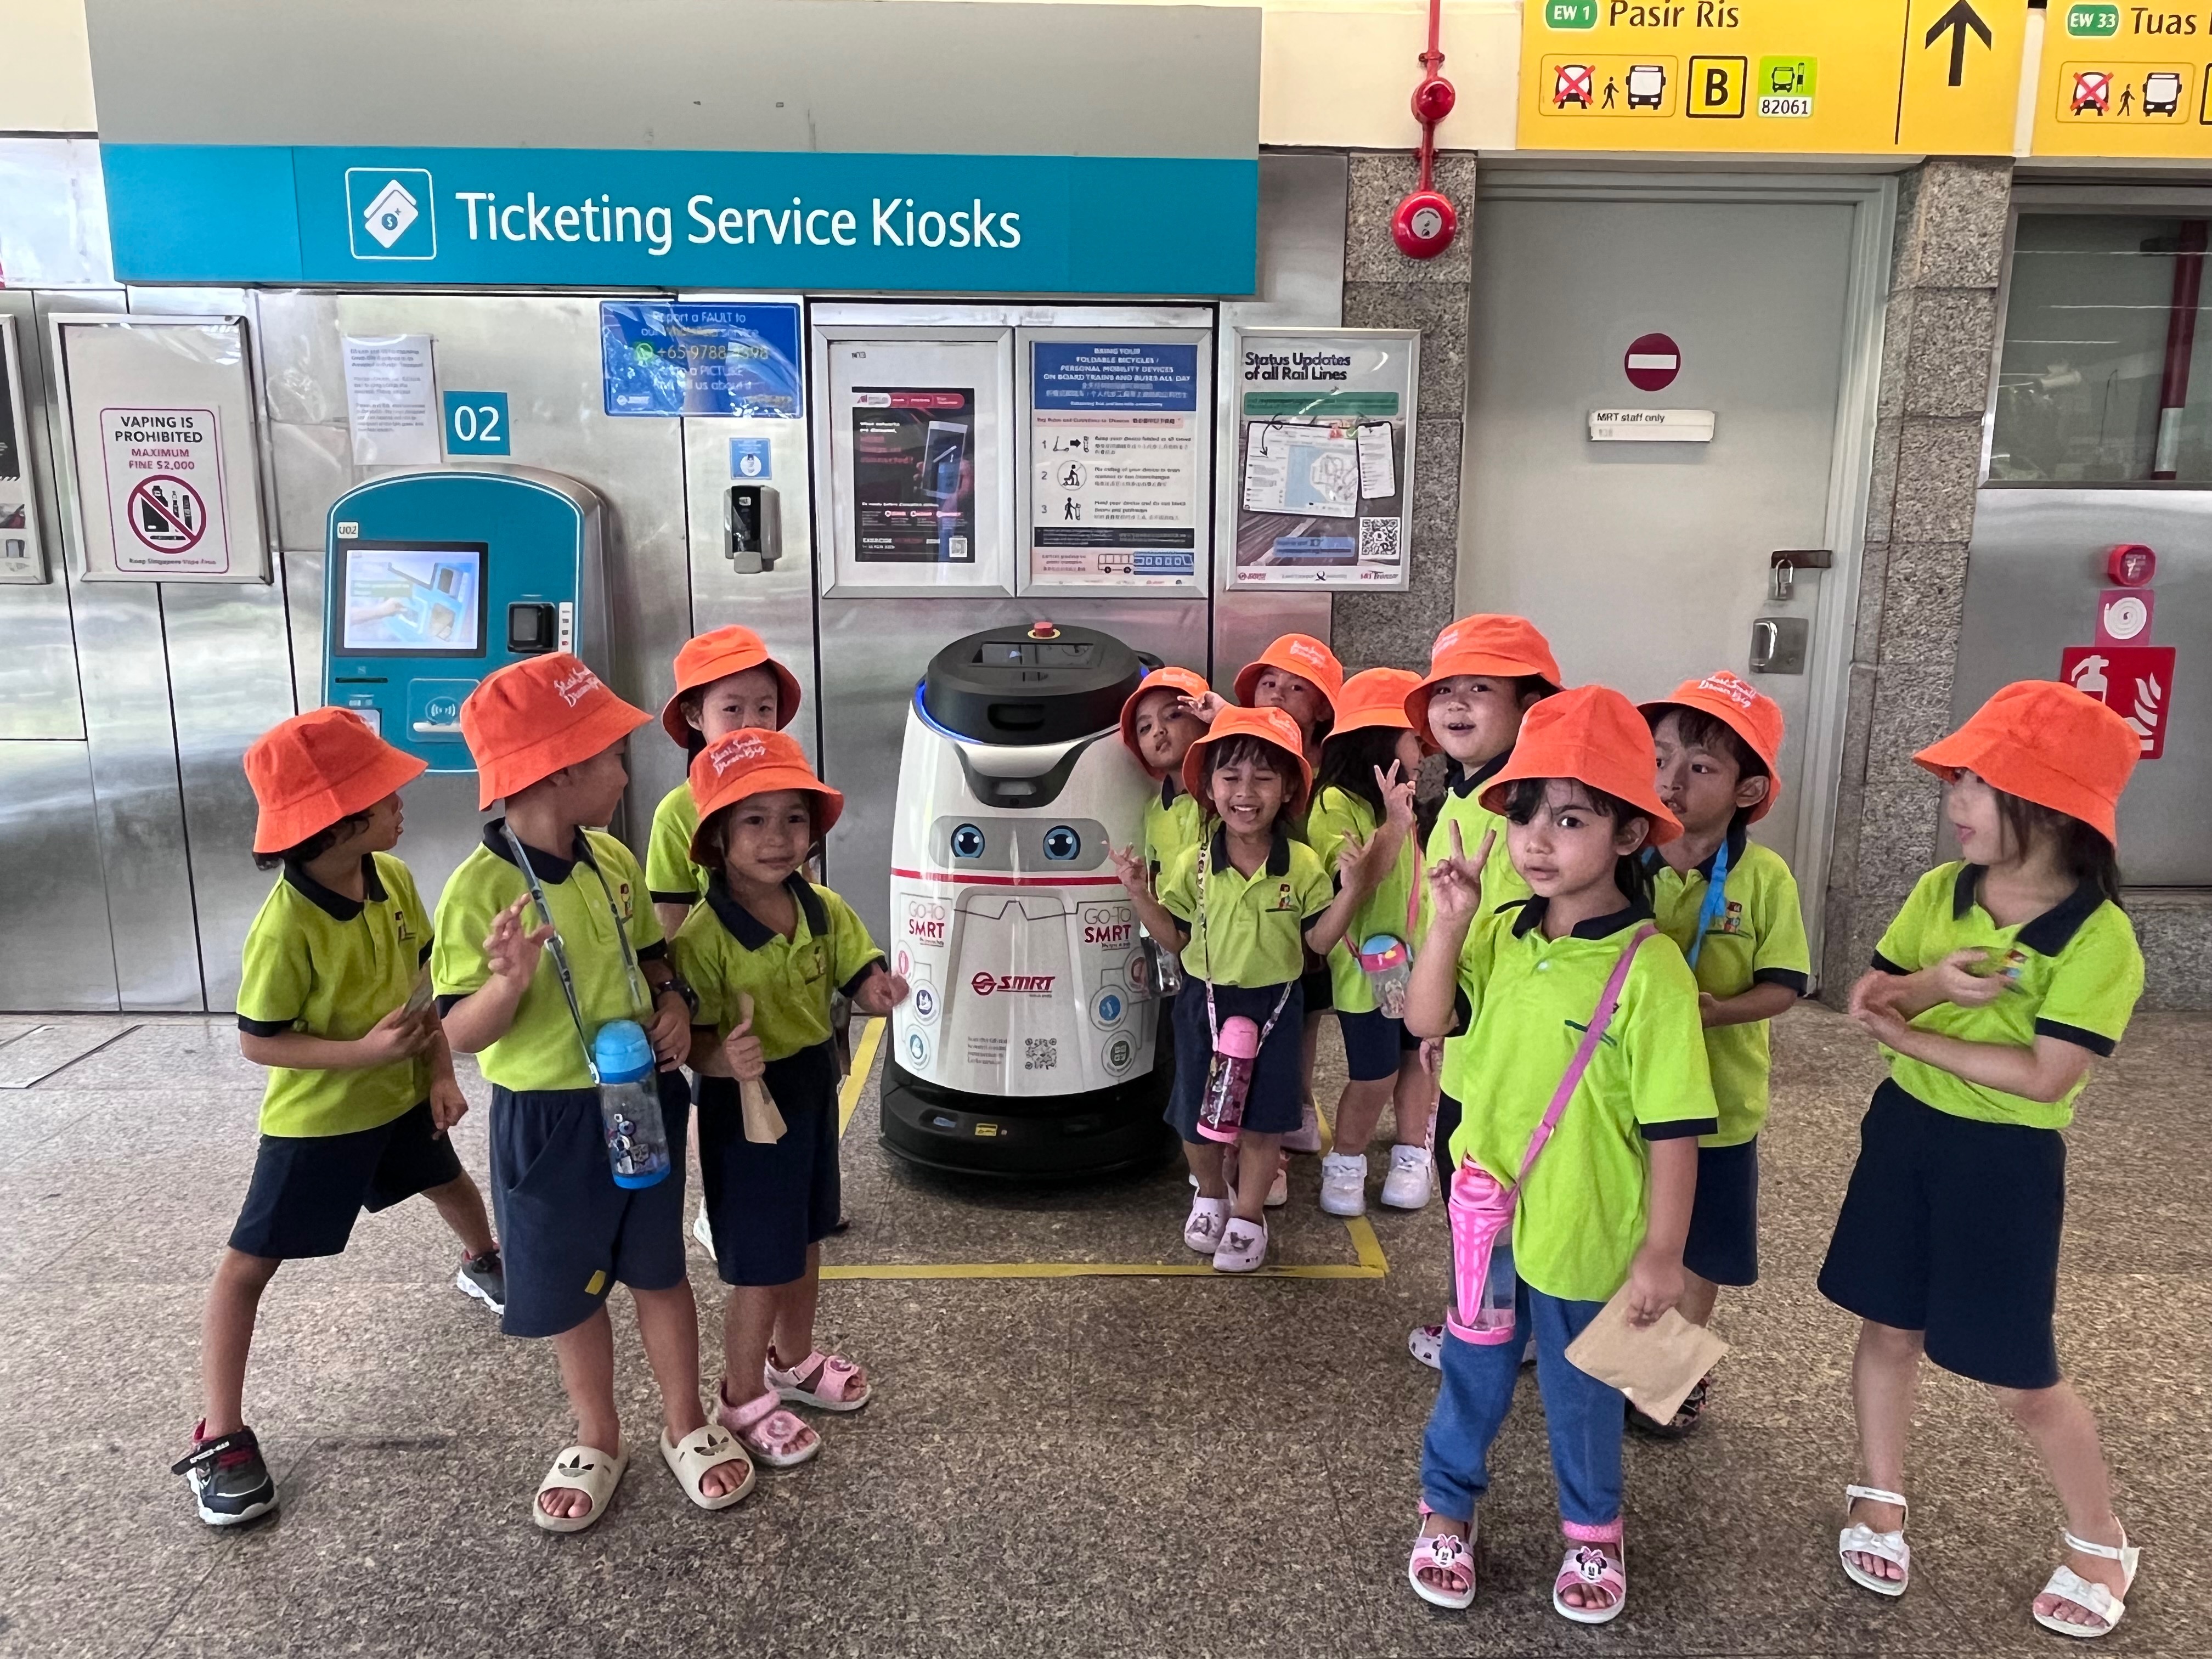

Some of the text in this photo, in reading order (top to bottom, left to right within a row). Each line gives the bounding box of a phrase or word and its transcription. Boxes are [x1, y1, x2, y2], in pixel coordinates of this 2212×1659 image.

[1553, 5, 1590, 21] EW 1
[1610, 0, 1739, 28] Pasir Ris
[2070, 13, 2116, 28] EW 33
[2130, 7, 2197, 35] Tuas
[1705, 68, 1728, 106] B
[1761, 99, 1808, 115] 82061
[456, 191, 1022, 256] Ticketing Service Kiosks
[692, 314, 698, 323] a
[702, 312, 732, 323] FAULT
[736, 313, 746, 323] to
[657, 345, 686, 359] +65
[690, 345, 726, 360] 9788
[1245, 352, 1351, 370] Status Updates
[1245, 365, 1347, 380] of all Rail Lines
[696, 382, 709, 391] us
[120, 416, 194, 428] VAPING IS
[454, 405, 501, 441] 02
[1597, 413, 1665, 424] MRT staff only
[115, 431, 203, 443] PROHIBITED
[131, 448, 190, 457] MAXIMUM
[129, 460, 153, 469] FINE
[1041, 471, 1047, 480] 2
[1041, 504, 1047, 514] 3
[339, 524, 357, 534] U02
[909, 901, 946, 921] GO-TO
[1084, 906, 1132, 925] GO-TO
[909, 918, 945, 939] SMRT
[1084, 924, 1132, 944] SMRT
[997, 976, 1056, 991] SMRT
